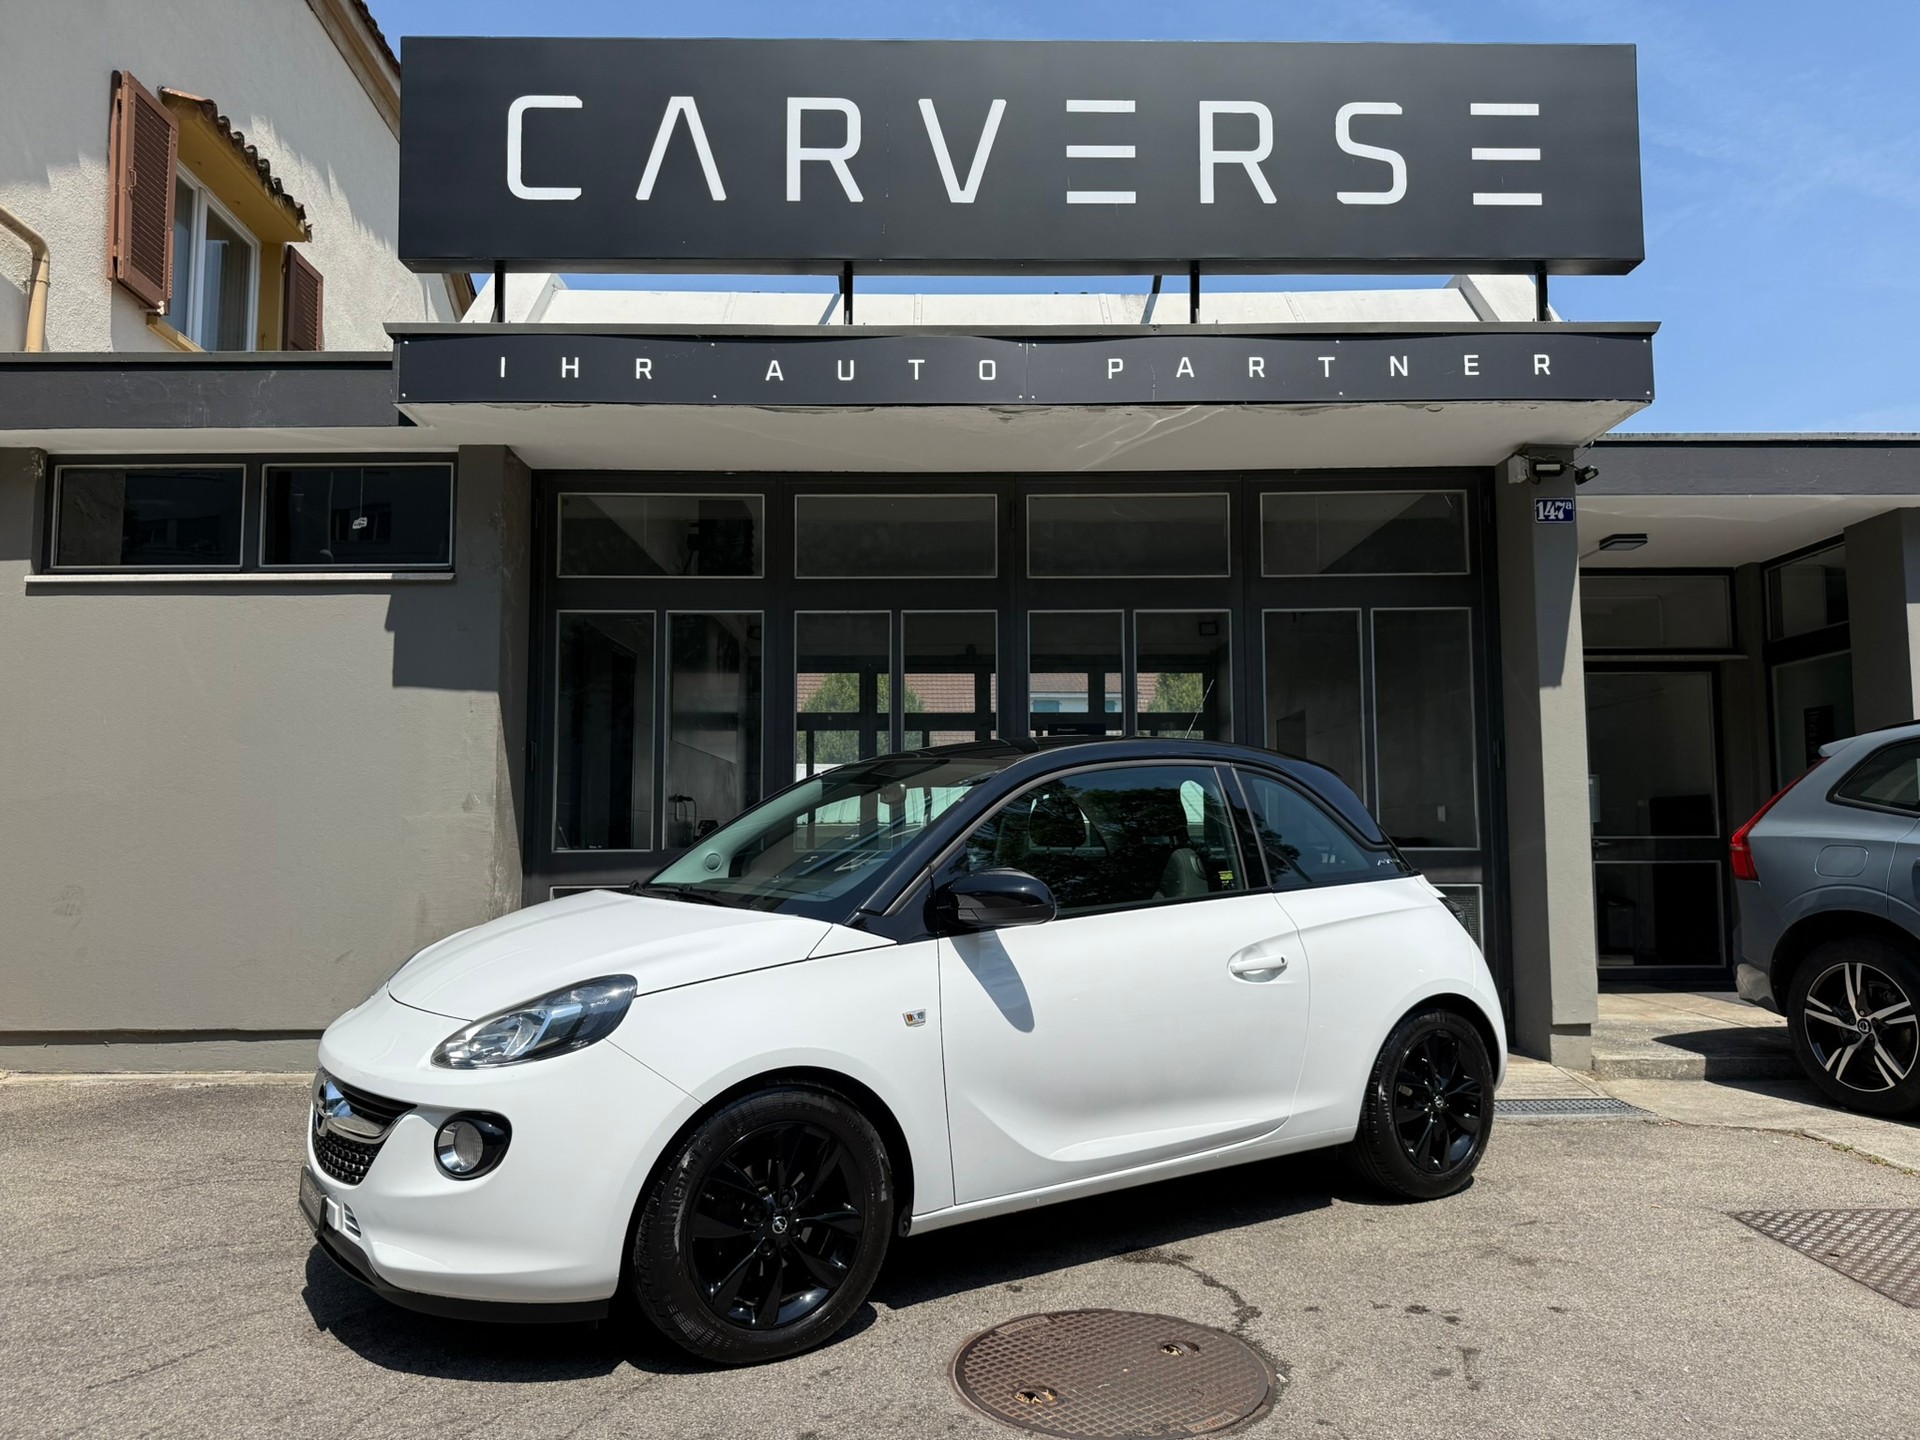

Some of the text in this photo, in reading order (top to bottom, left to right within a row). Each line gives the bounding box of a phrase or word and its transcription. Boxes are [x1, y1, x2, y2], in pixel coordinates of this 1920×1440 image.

[507, 95, 1542, 205] CARVERSE
[501, 354, 1550, 381] IHR AUTO PARTNER
[1536, 500, 1572, 520] 147a
